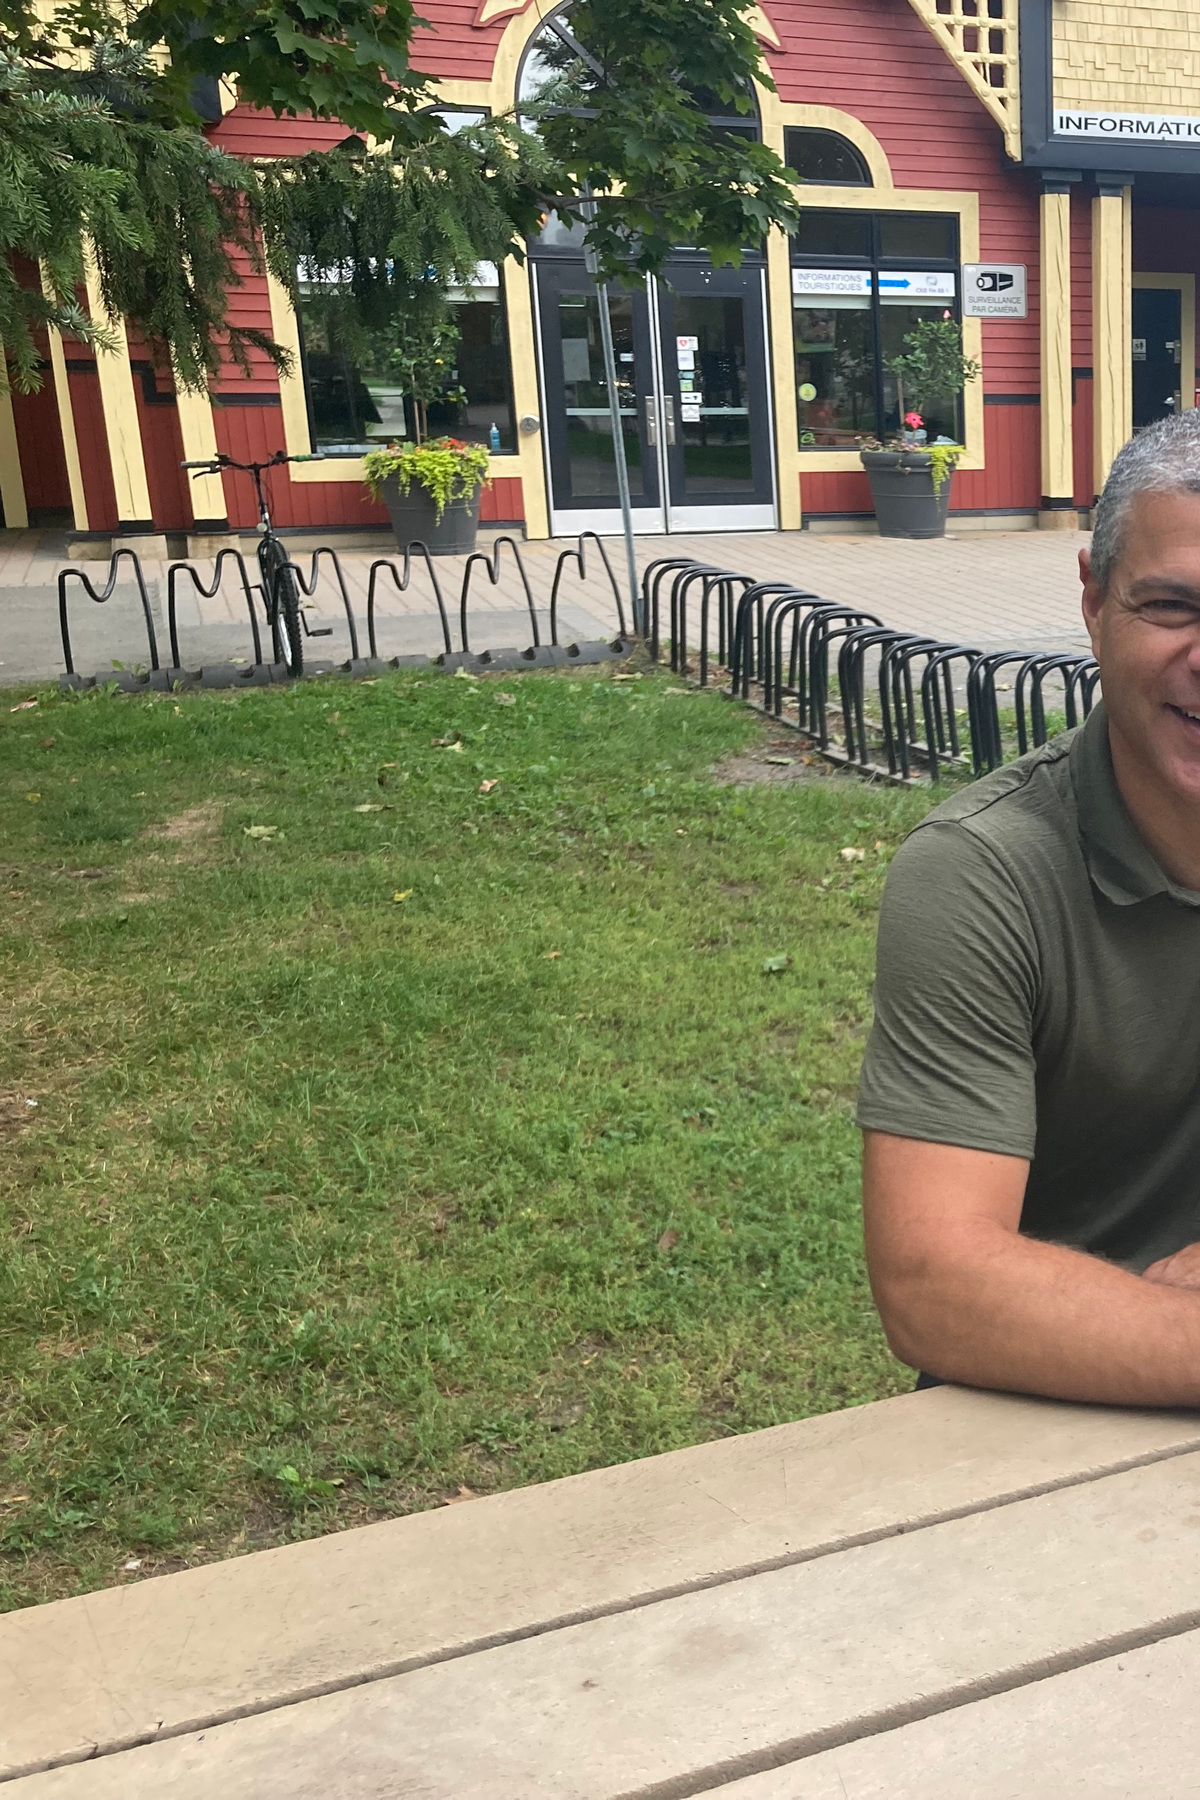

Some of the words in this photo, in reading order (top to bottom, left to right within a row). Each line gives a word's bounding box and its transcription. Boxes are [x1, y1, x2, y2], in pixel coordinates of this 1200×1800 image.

[797, 273, 862, 283] INFORMATIONS
[798, 281, 862, 291] TOURISTIQUES
[968, 296, 1022, 304] SURVEILLANCE
[972, 305, 986, 313] PAR
[988, 305, 1019, 314] CAMÉRA
